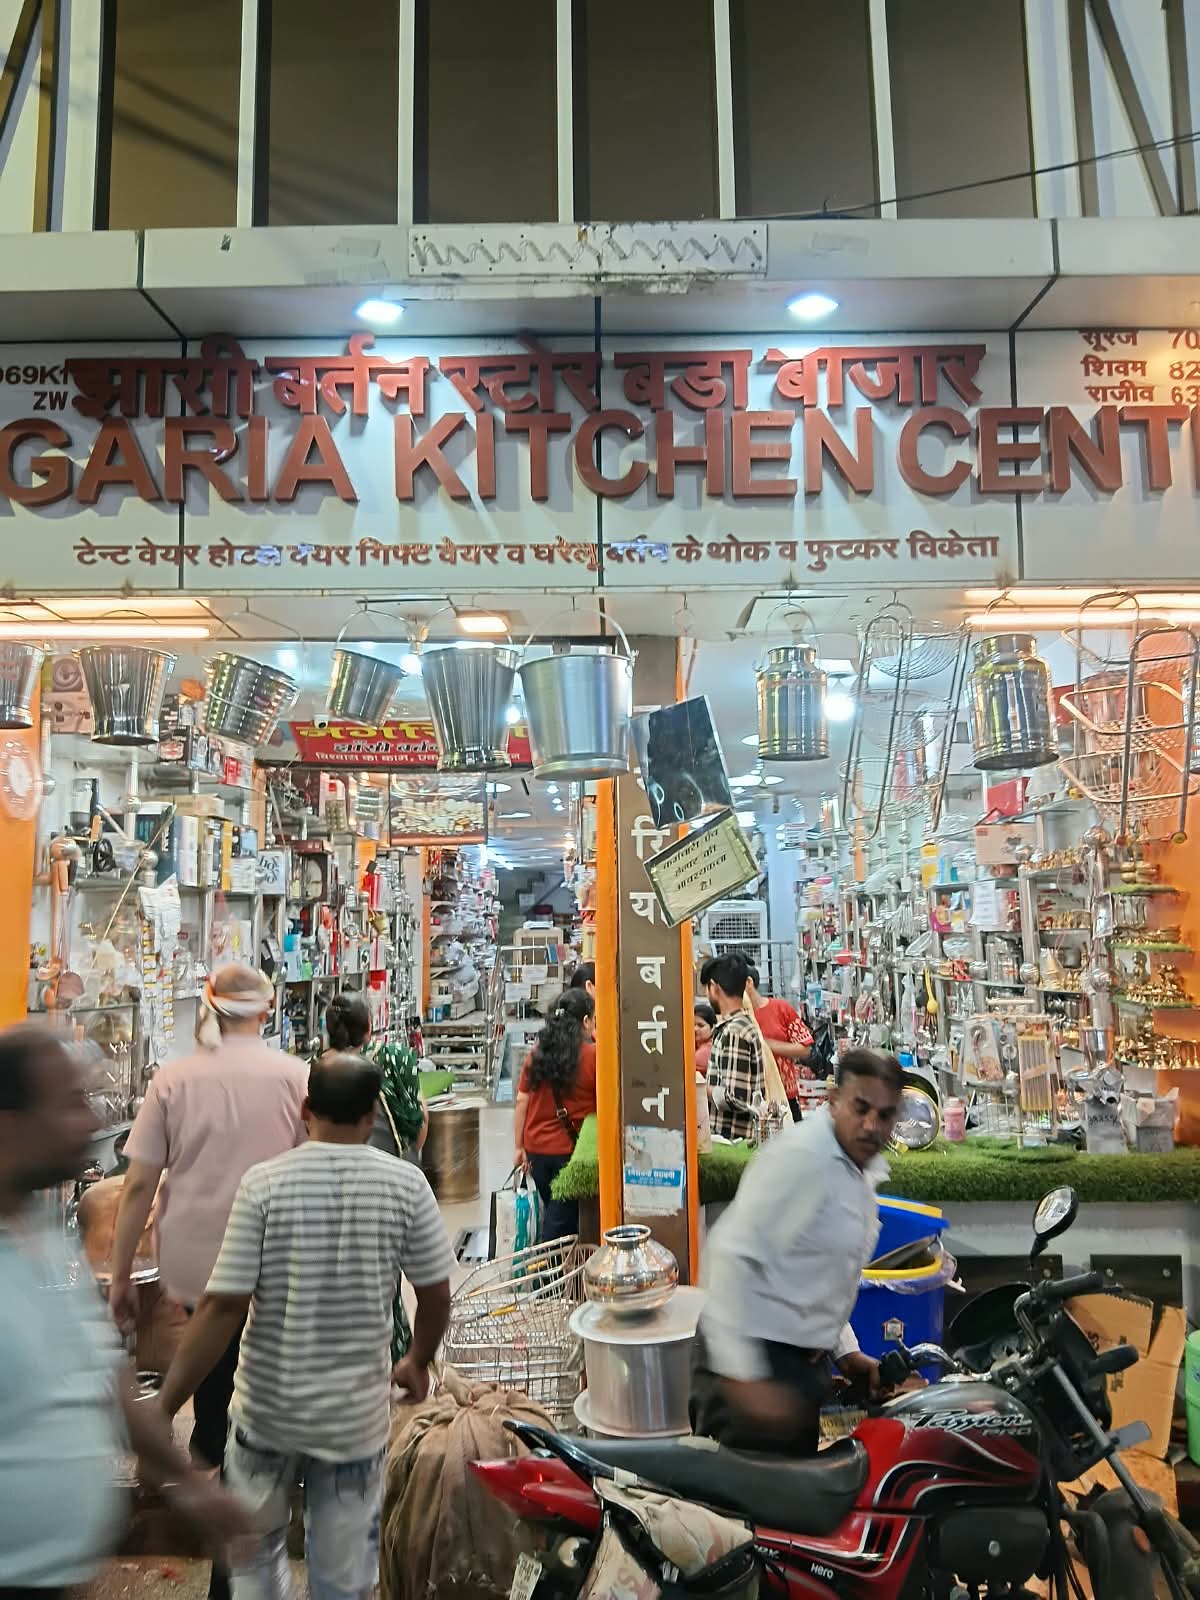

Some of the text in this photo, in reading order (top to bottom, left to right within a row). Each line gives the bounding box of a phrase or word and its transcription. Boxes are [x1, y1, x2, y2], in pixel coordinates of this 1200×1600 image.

[265, 333, 430, 416] बर्तन
[439, 330, 602, 414] स्टोर
[766, 344, 986, 408] बाजार
[1080, 354, 1147, 377] शिवम
[33, 390, 69, 411] ZW
[1085, 379, 1155, 402] राजीव
[394, 406, 874, 499] KITCHEN
[897, 404, 1200, 496] CENT
[73, 536, 132, 566] टेन्ट
[135, 536, 201, 566] वेयर
[356, 536, 433, 567] गिफ्ट
[504, 542, 527, 565] व
[672, 533, 704, 563] के
[706, 533, 771, 563] थोक
[775, 540, 798, 562] व
[804, 539, 900, 573] फुटकर
